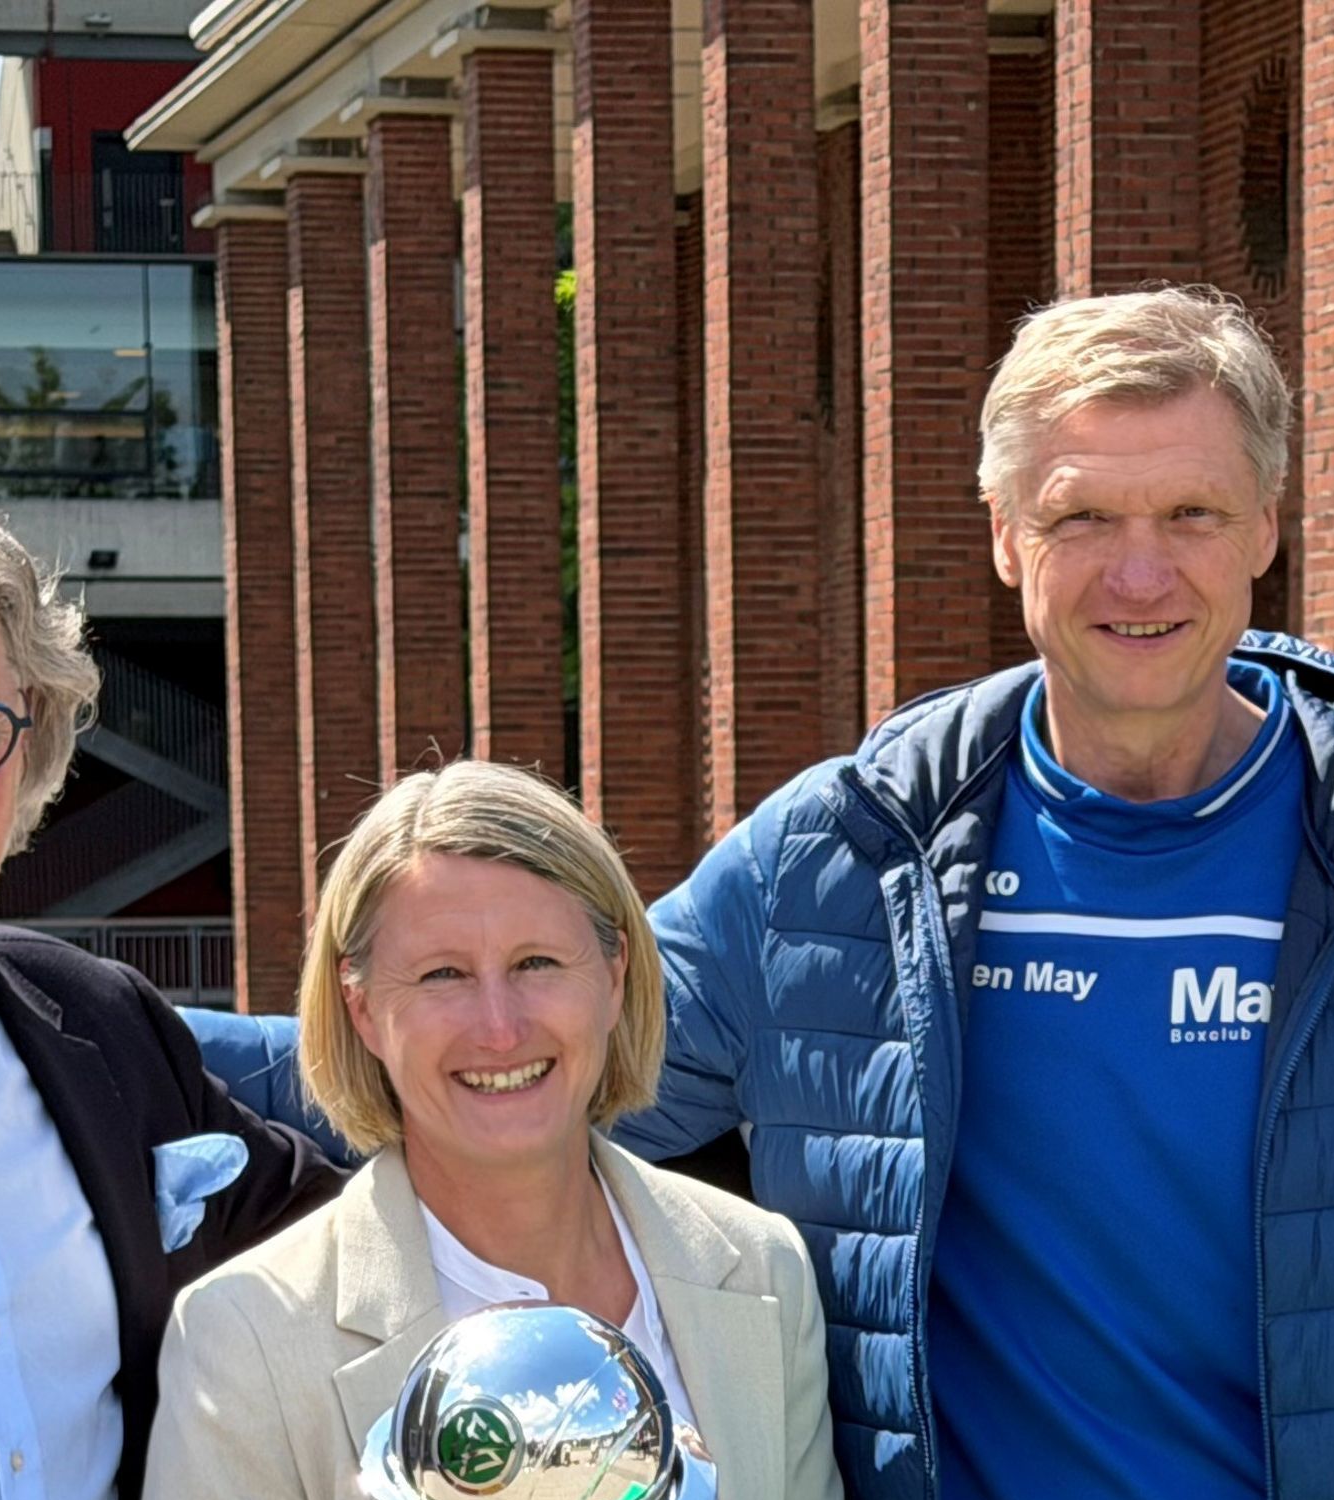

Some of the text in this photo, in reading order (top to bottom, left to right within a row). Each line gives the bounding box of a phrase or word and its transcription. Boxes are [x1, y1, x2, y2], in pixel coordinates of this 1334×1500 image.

[1024, 961, 1098, 1002] May
[1170, 966, 1275, 1025] Ma
[1170, 1026, 1252, 1044] Boxclub
